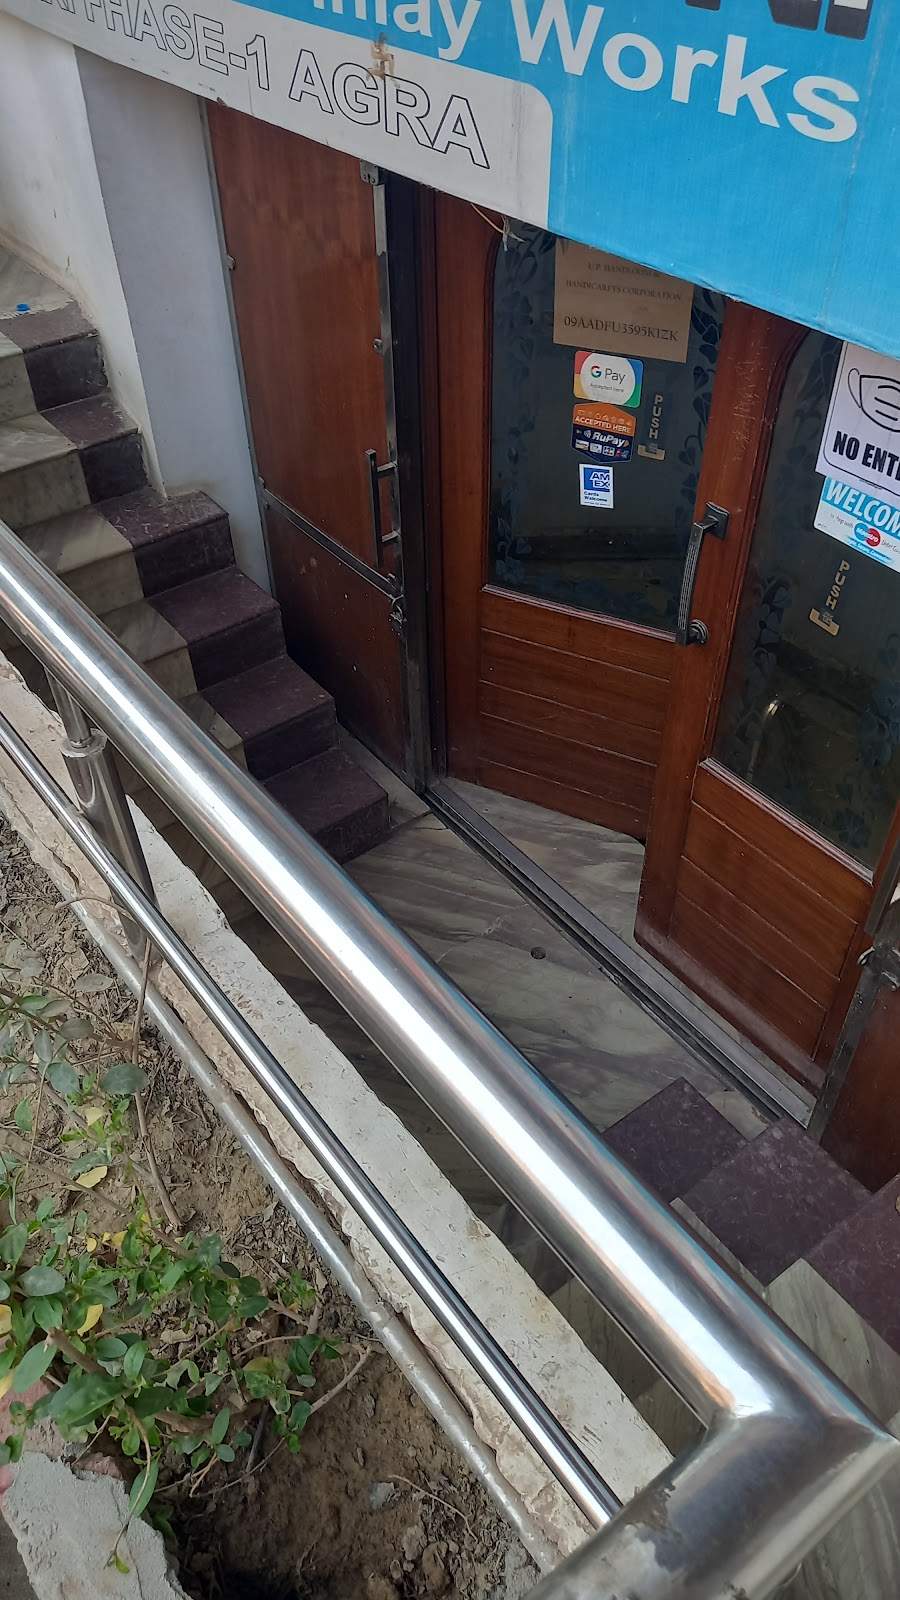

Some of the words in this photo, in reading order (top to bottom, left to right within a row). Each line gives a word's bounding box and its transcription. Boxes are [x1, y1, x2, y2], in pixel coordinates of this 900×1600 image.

[513, 0, 861, 143] Works
[288, 49, 490, 170] AGRA
[622, 286, 681, 301] CORPORATION
[604, 368, 626, 385] Pay
[574, 416, 611, 429] ACCEPTED
[612, 423, 632, 434] HERE
[648, 394, 664, 440] PUSH
[591, 431, 626, 448] RuPay
[832, 430, 860, 461] NO
[583, 495, 608, 503] Welcome
[825, 559, 851, 610] PUSH
